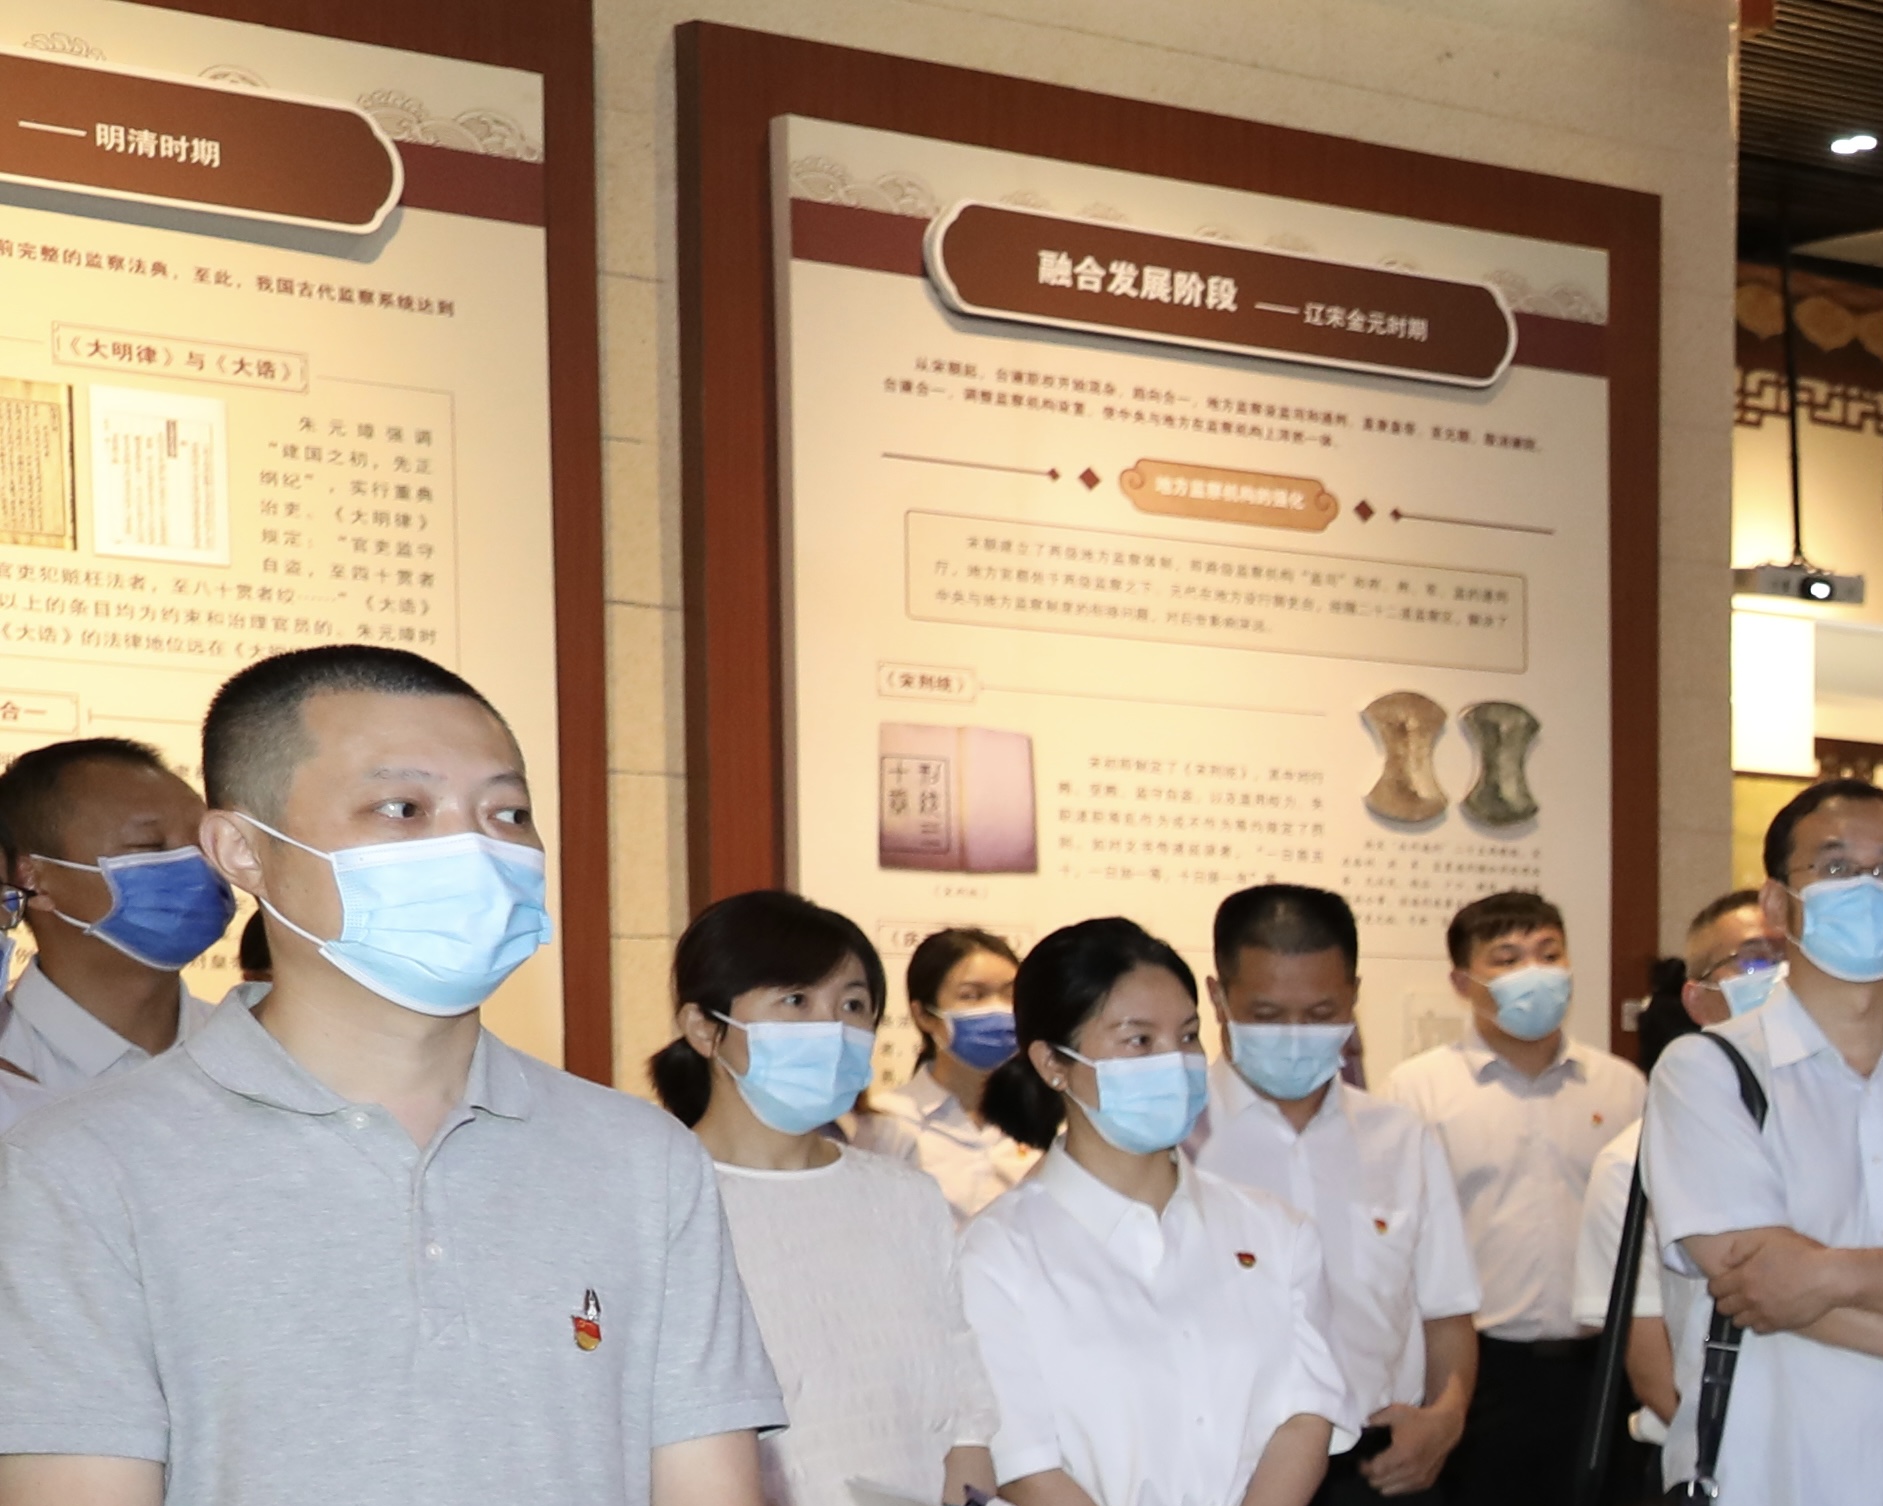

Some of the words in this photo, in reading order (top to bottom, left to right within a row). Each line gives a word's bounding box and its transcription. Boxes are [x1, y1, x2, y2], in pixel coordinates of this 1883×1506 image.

[95, 122, 220, 168] 明清时期
[1037, 249, 1239, 312] 融合发展阶段
[1303, 302, 1429, 342] 辽宋金元时期
[69, 336, 292, 382] 《大明律》与《大诰》
